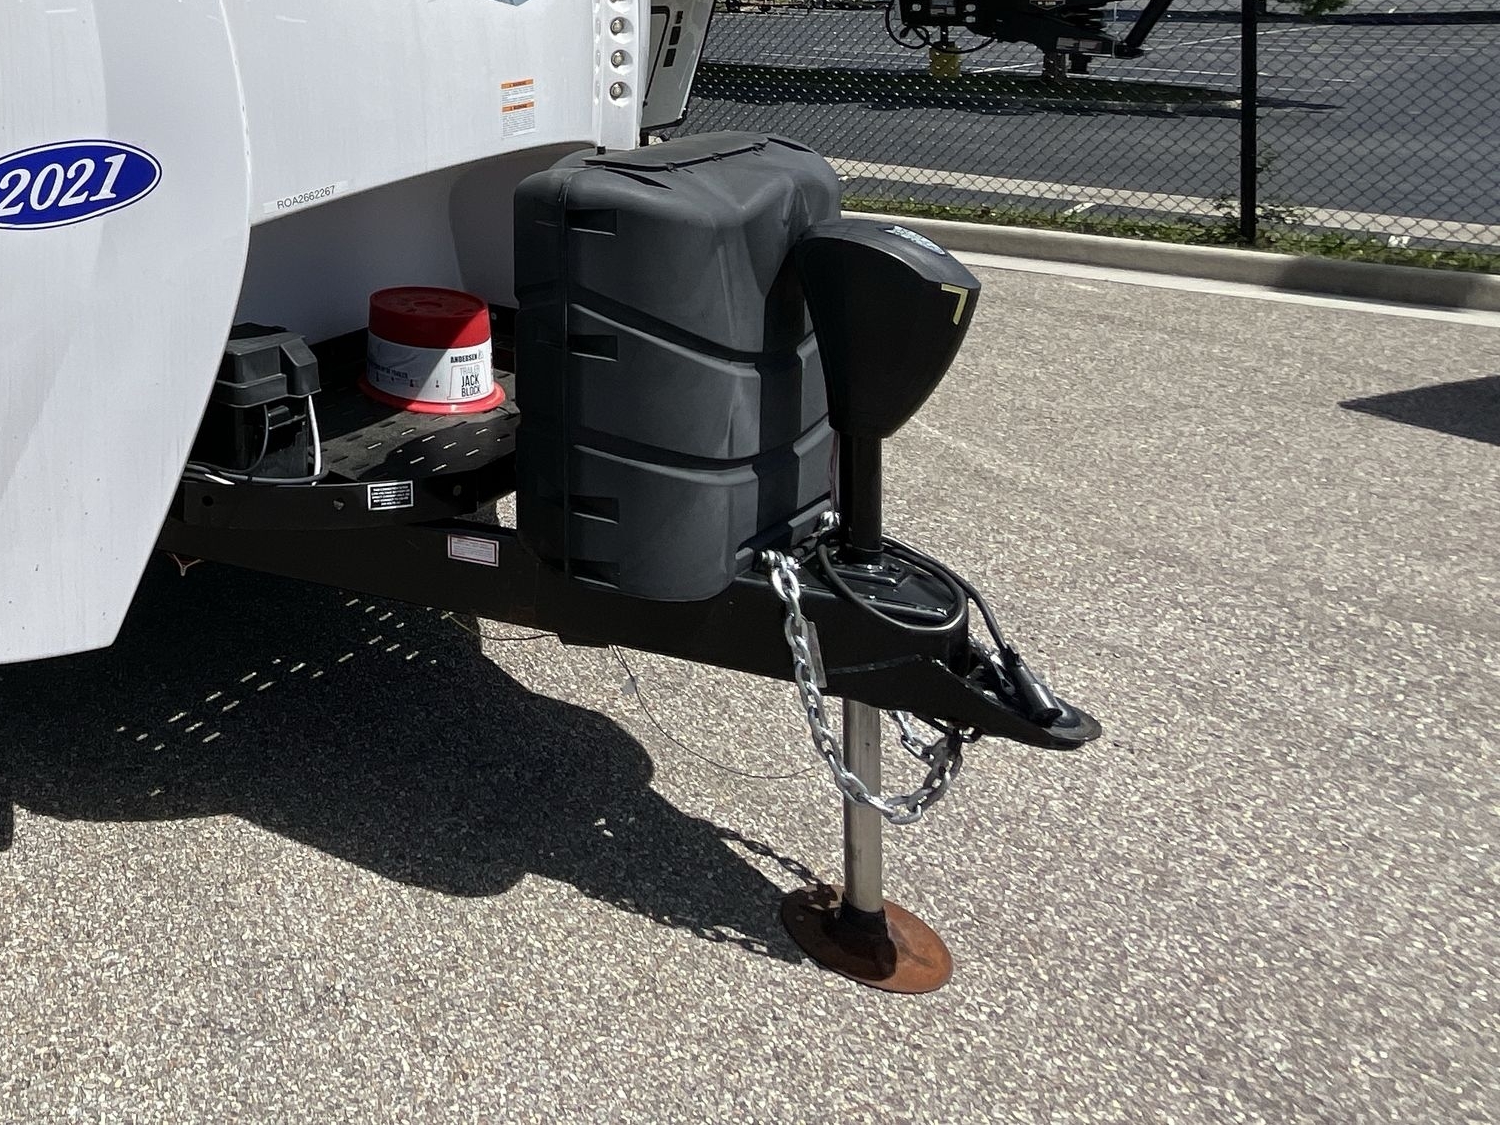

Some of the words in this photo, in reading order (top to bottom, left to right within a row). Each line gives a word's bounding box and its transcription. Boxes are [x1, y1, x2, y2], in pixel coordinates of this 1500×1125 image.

[276, 184, 336, 210] ROA2662267
[461, 374, 480, 387] JACK
[461, 385, 480, 397] BLOCK
